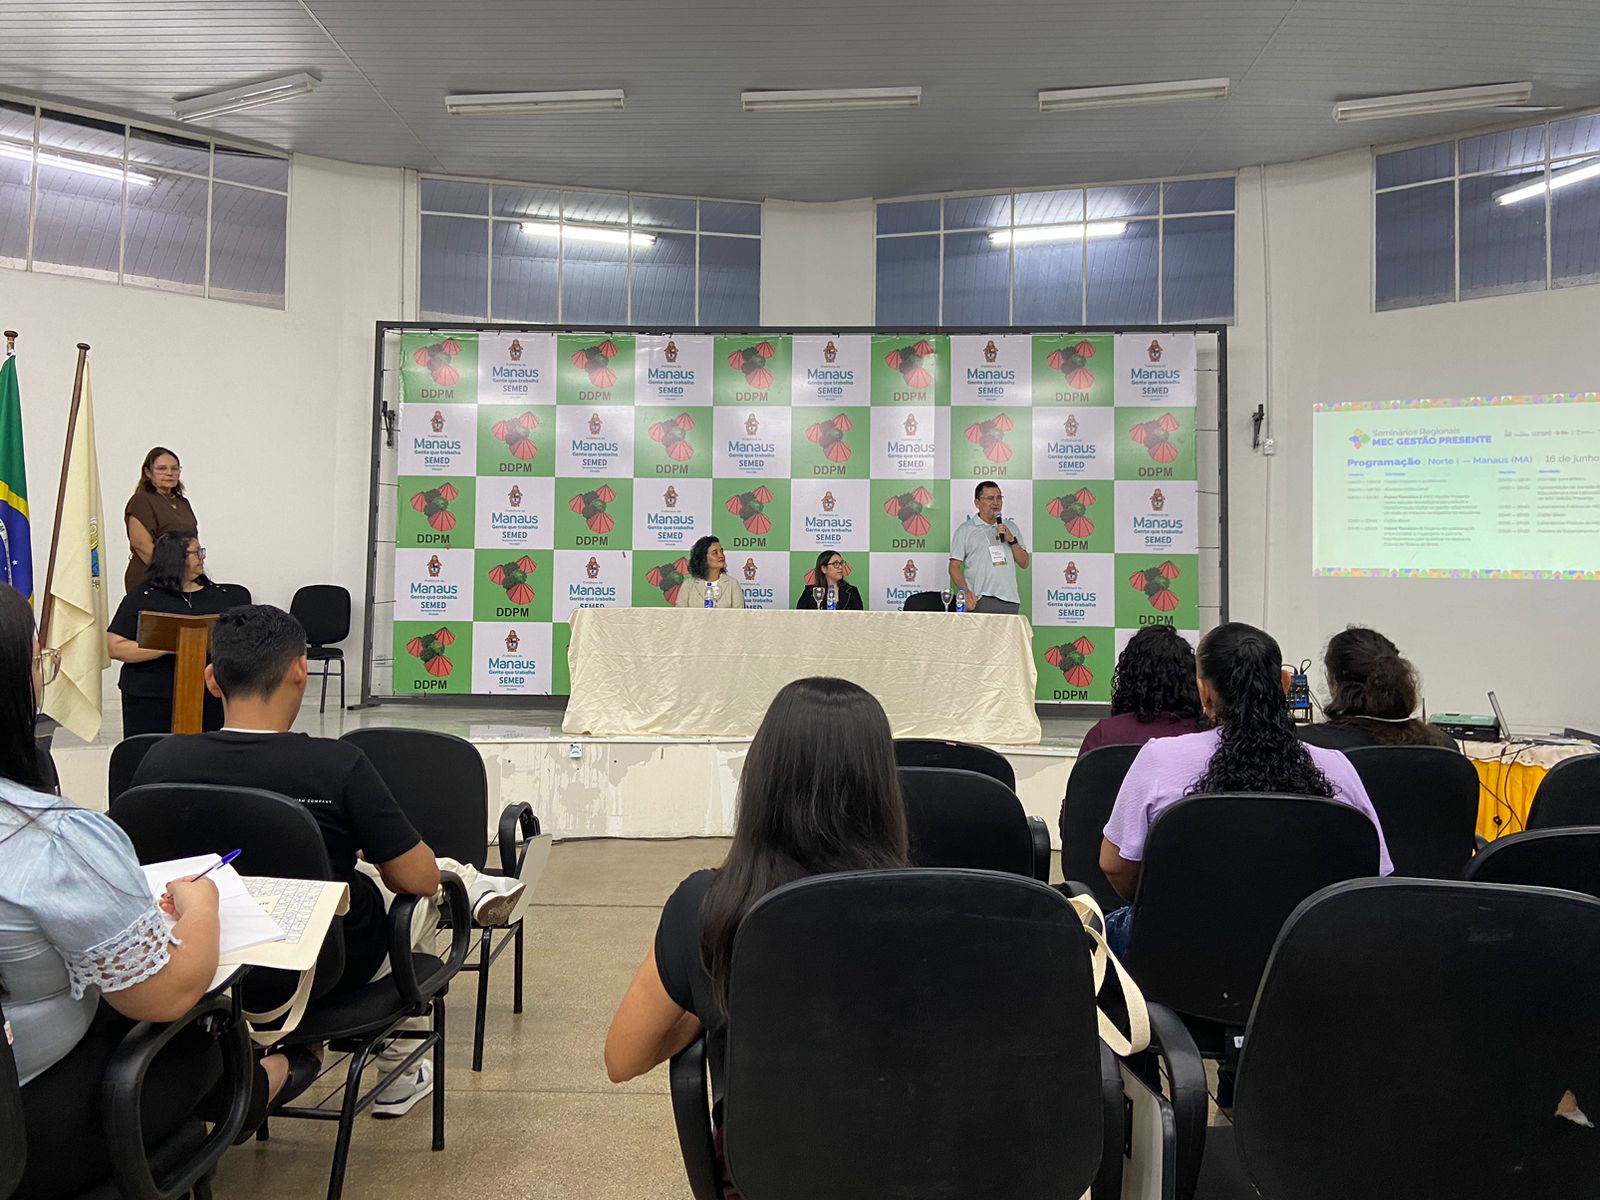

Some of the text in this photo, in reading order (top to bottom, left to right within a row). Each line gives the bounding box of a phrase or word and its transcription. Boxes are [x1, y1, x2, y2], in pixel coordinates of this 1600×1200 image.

[492, 366, 538, 377] Manaus
[648, 368, 694, 379] Manaus
[808, 369, 853, 380] Manaus
[967, 368, 1015, 379] Manaus
[1131, 368, 1180, 379] Manaus
[421, 389, 454, 399] DDPM
[579, 392, 611, 400] DDPM
[736, 392, 768, 401] DDPM
[894, 392, 926, 401] DDPM
[1056, 393, 1089, 402] DDPM
[414, 438, 461, 449] Manaus
[572, 440, 618, 451] Manaus
[1372, 435, 1492, 446] MEC GESTÃO PRESENTE
[729, 441, 775, 452] Manaus
[888, 442, 935, 453] Manaus
[1048, 442, 1095, 454] Manaus
[1347, 457, 1421, 468] Programação
[1473, 456, 1508, 464] Manaus
[1511, 455, 1533, 464] (MA)
[1545, 455, 1555, 463] 16
[1558, 455, 1570, 463] de
[499, 463, 532, 473] DDPM
[656, 465, 688, 474] DDPM
[813, 465, 846, 475] DDPM
[973, 466, 1007, 476] DDPM
[1139, 467, 1173, 477] DDPM
[492, 513, 538, 524] Manaus
[648, 513, 694, 524] Manaus
[806, 516, 852, 527] Manaus
[1134, 517, 1182, 528] Manaus
[417, 534, 449, 544] DDPM
[576, 536, 608, 546] DDPM
[734, 538, 766, 547] DDPM
[892, 539, 925, 548] DDPM
[1054, 541, 1088, 550] DDPM
[411, 583, 457, 593] Manaus
[570, 584, 615, 595] Manaus
[742, 588, 774, 597] naus
[1048, 590, 1096, 601] Manaus
[496, 608, 529, 617] DDPM
[1139, 615, 1174, 624] DDPM
[489, 658, 535, 669] Manaus
[414, 680, 447, 690] DDPM
[1053, 690, 1088, 700] DDPM
